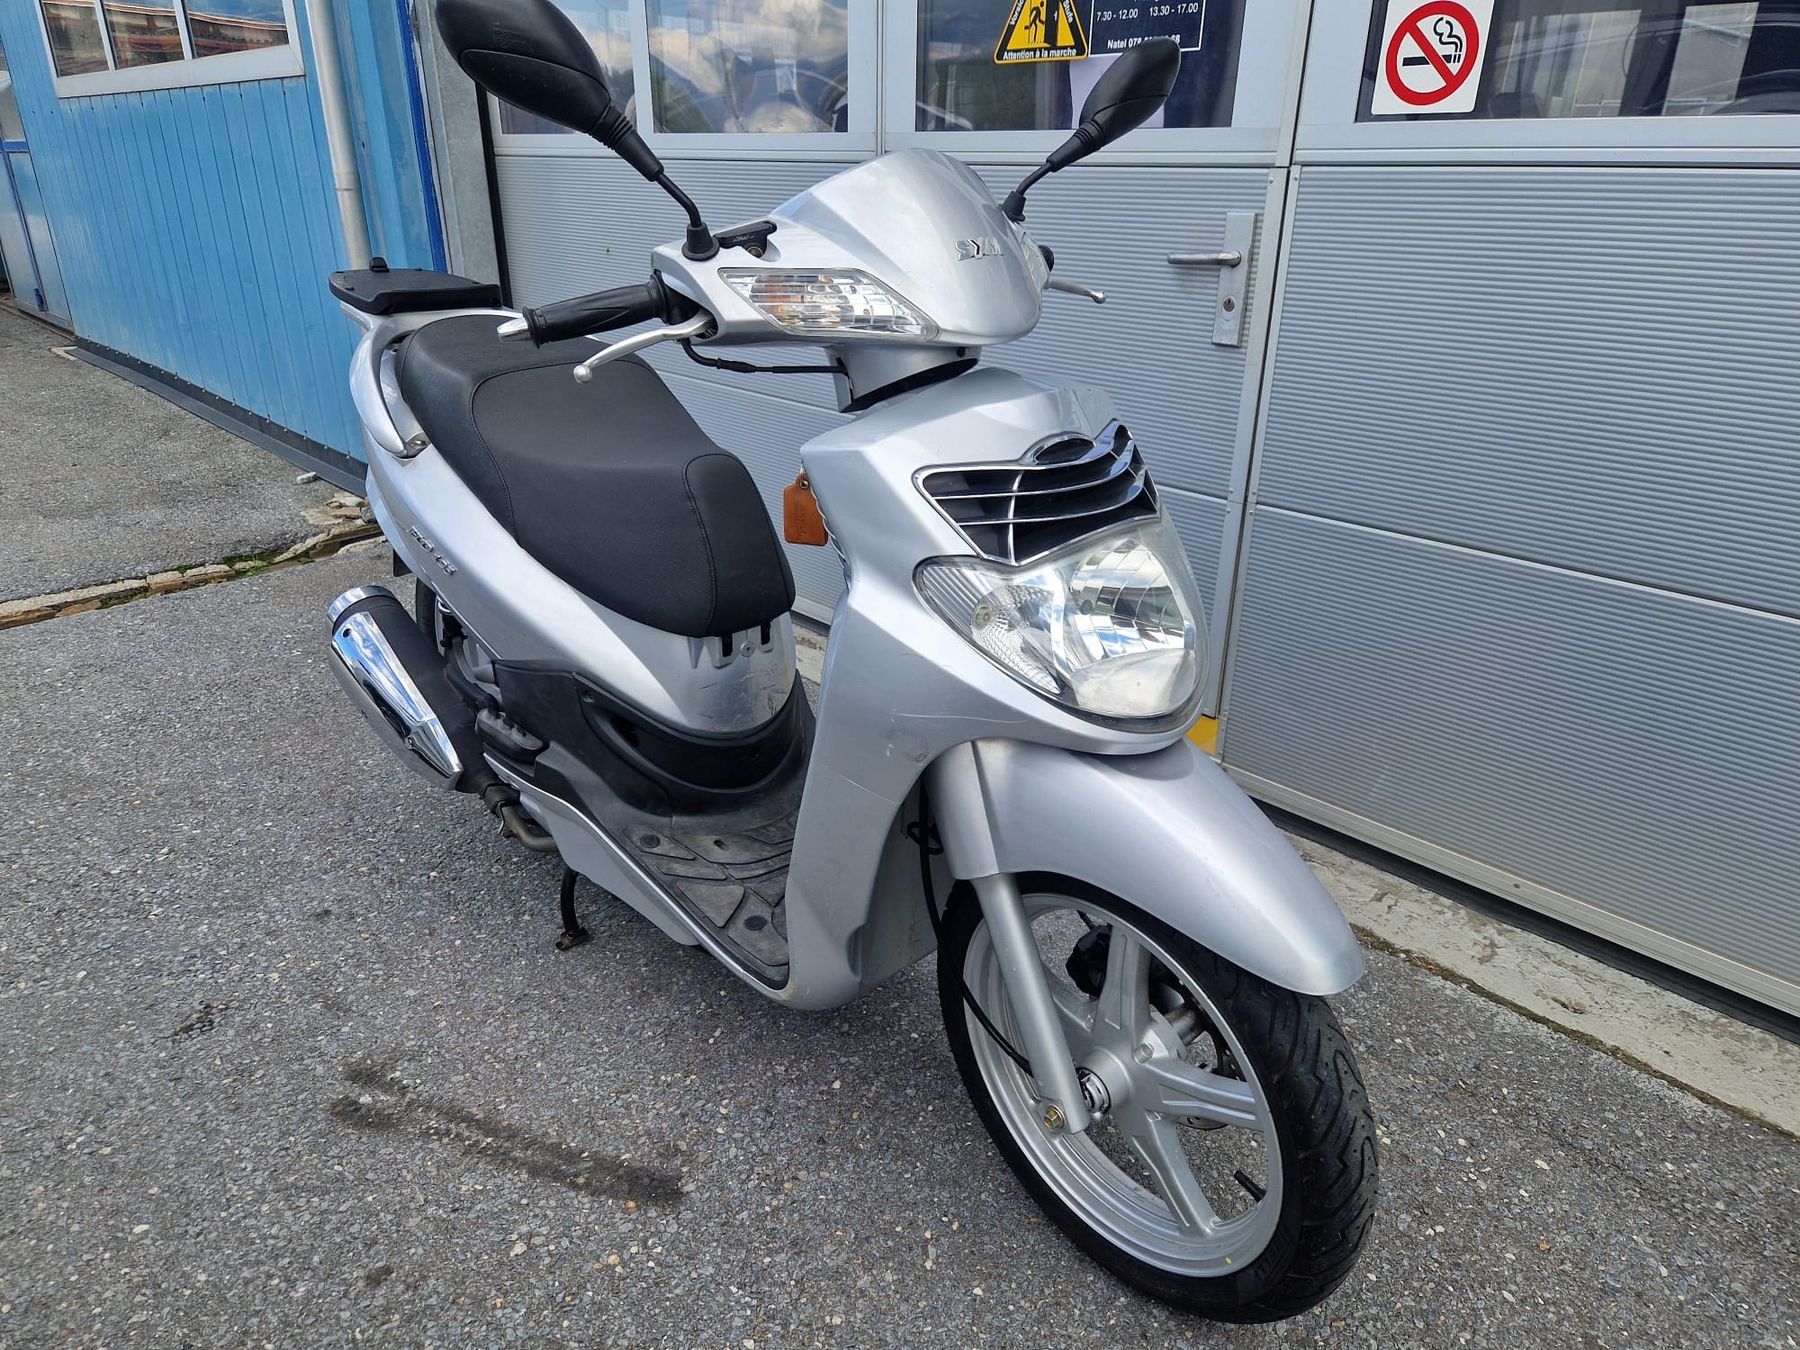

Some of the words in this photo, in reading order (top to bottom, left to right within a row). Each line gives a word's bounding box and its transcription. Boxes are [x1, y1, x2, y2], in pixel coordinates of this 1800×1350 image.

[1096, 11, 1112, 22] 7.30
[1119, 8, 1139, 20] 12.00
[1149, 5, 1170, 17] 13.30
[1177, 2, 1199, 14] 17.00
[1107, 38, 1127, 50] Natel
[1003, 50, 1034, 60] Attention
[1041, 48, 1048, 57] la
[1049, 47, 1077, 57] marche
[955, 237, 1003, 261] SYM
